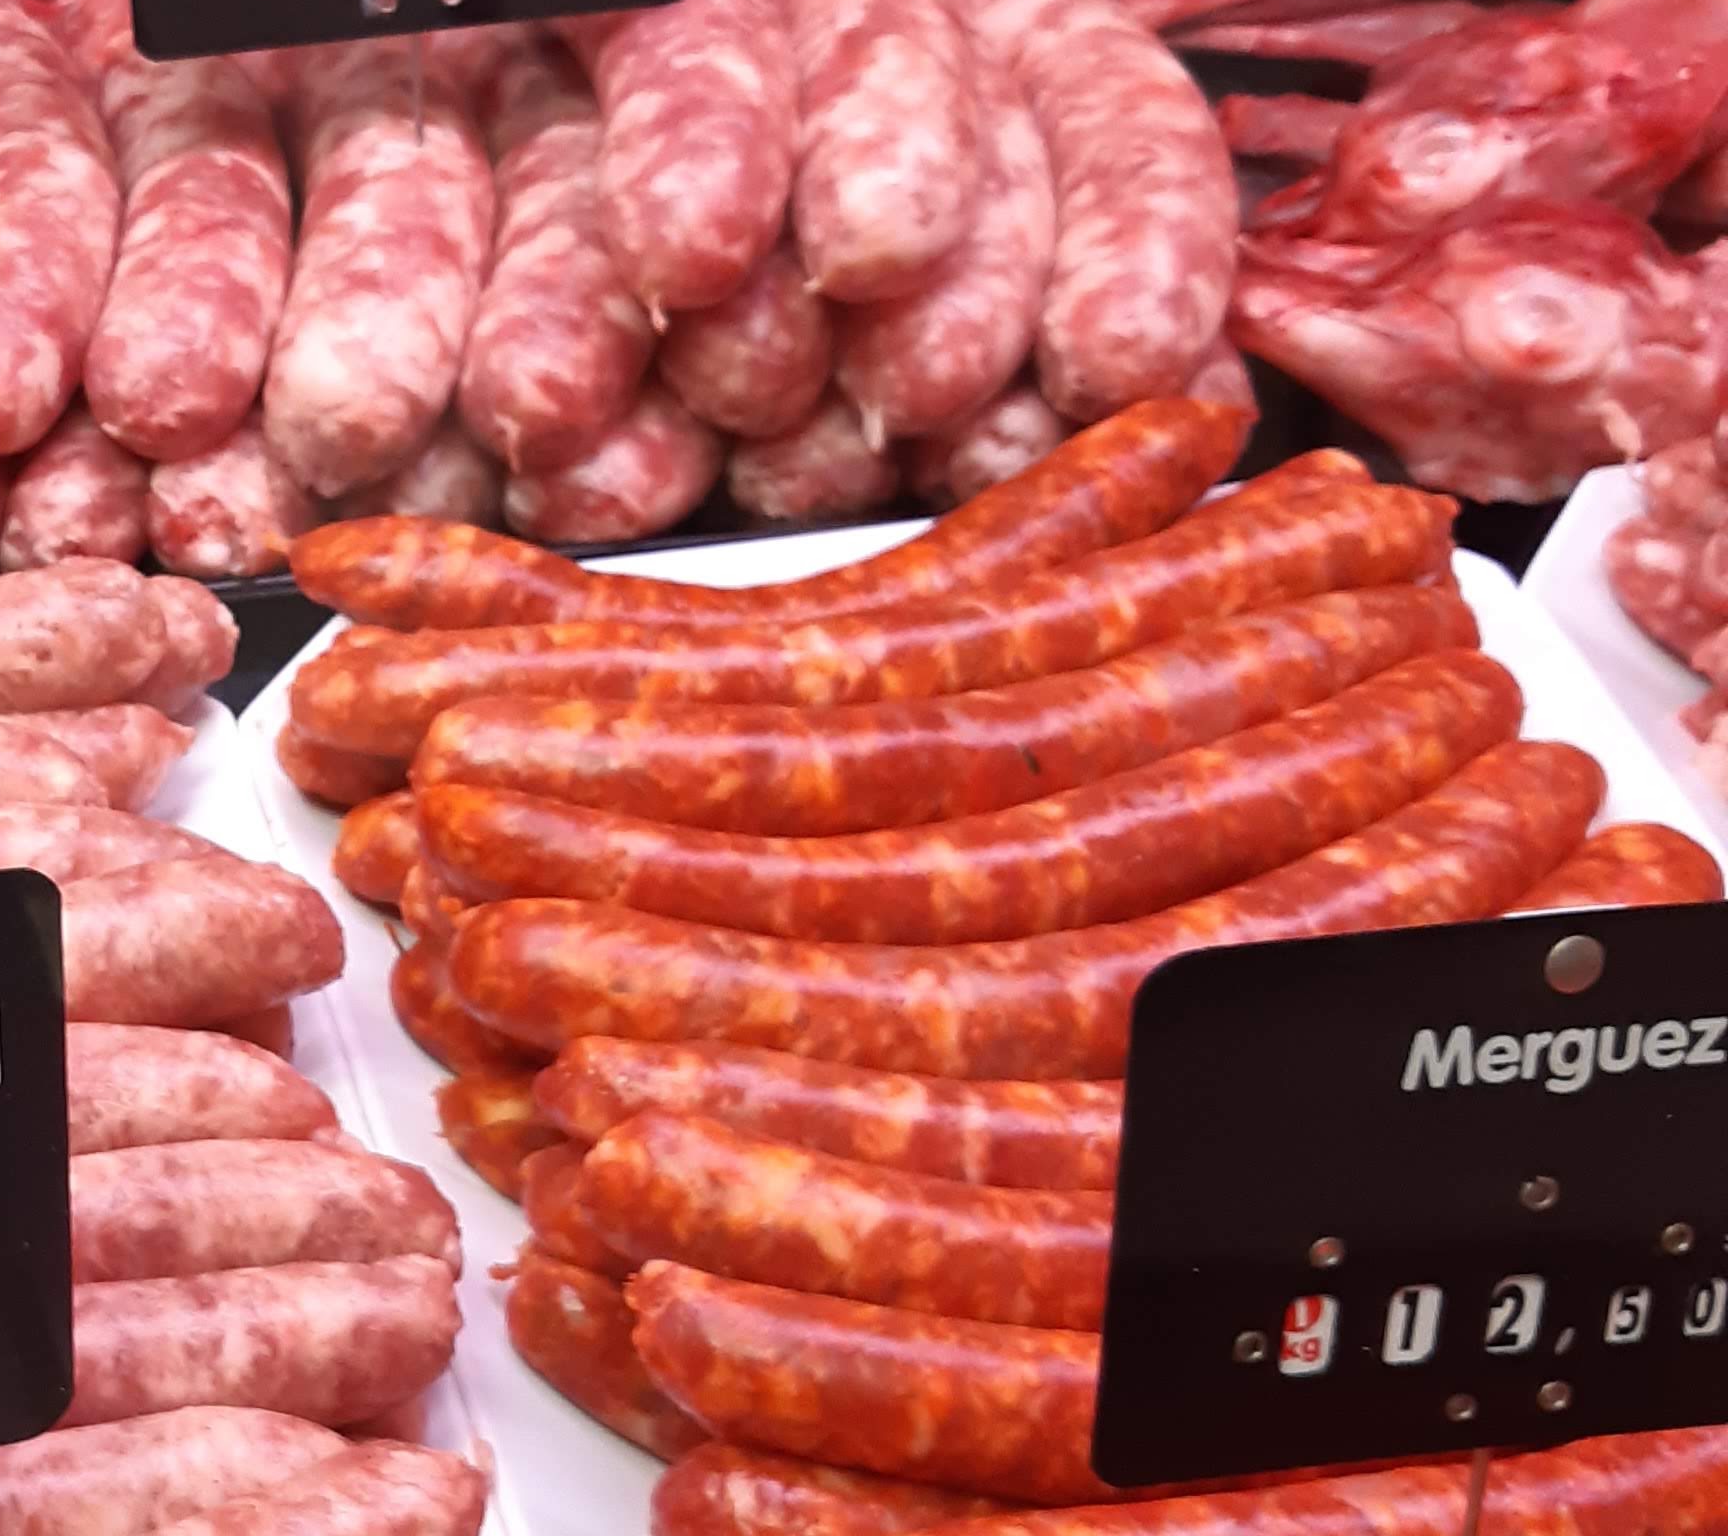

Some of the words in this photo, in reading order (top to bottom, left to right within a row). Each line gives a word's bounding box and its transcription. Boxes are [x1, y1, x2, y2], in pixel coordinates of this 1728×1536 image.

[1400, 1015, 1728, 1095] Merguez
[1280, 1336, 1321, 1363] kg
[1396, 1278, 1722, 1355] 12,50
